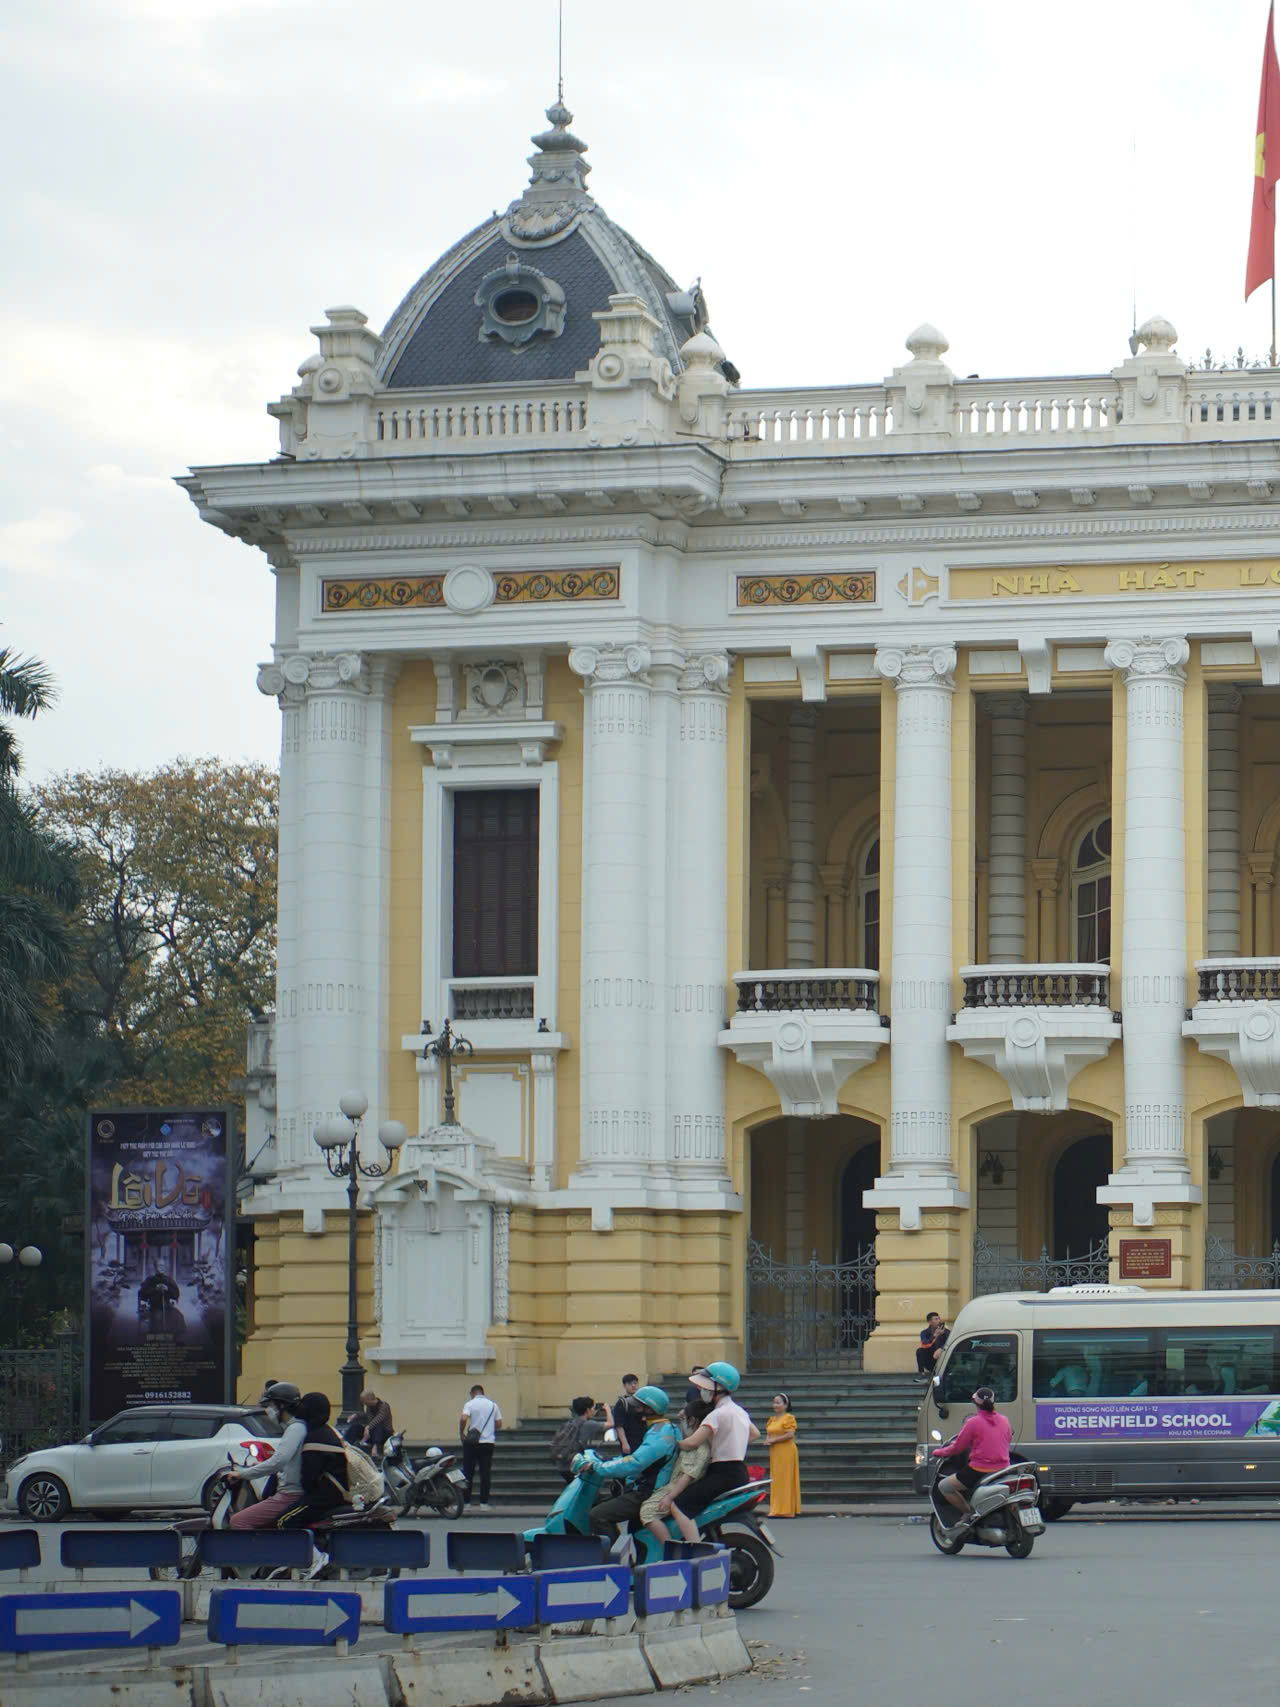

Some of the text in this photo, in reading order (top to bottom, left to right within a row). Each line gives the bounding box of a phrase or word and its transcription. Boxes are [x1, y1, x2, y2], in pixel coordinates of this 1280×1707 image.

[991, 565, 1083, 595] NHÀ
[1118, 562, 1205, 591] HÁT
[145, 1391, 192, 1399] 0916152882
[1054, 1414, 1232, 1428] GREENFIELD SCHOOL
